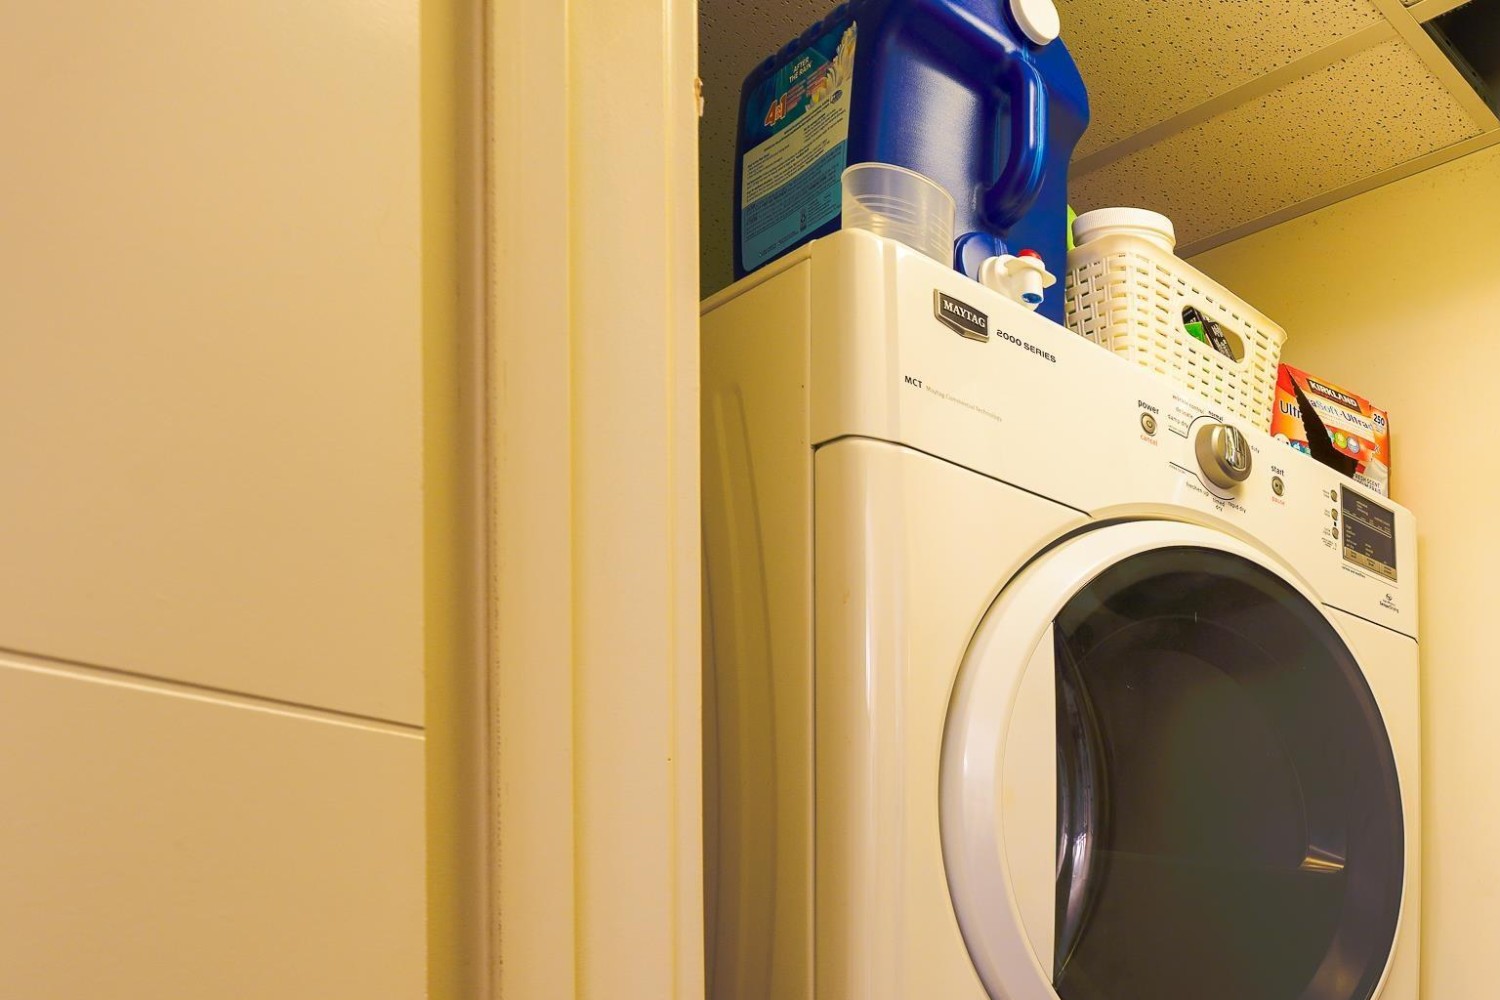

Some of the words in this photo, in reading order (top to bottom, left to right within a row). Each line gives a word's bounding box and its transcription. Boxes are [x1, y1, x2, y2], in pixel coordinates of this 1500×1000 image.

[793, 56, 810, 73] AFTER
[942, 299, 987, 328] MAYTAG
[996, 329, 1022, 347] 2000
[1023, 342, 1057, 363] SERIES
[904, 375, 923, 389] MCT
[1309, 380, 1358, 407] KIRKLAND
[1138, 399, 1159, 415] power
[1208, 410, 1224, 422] normal
[1373, 413, 1385, 426] 250
[1140, 434, 1158, 447] cancel
[1270, 465, 1285, 476] start
